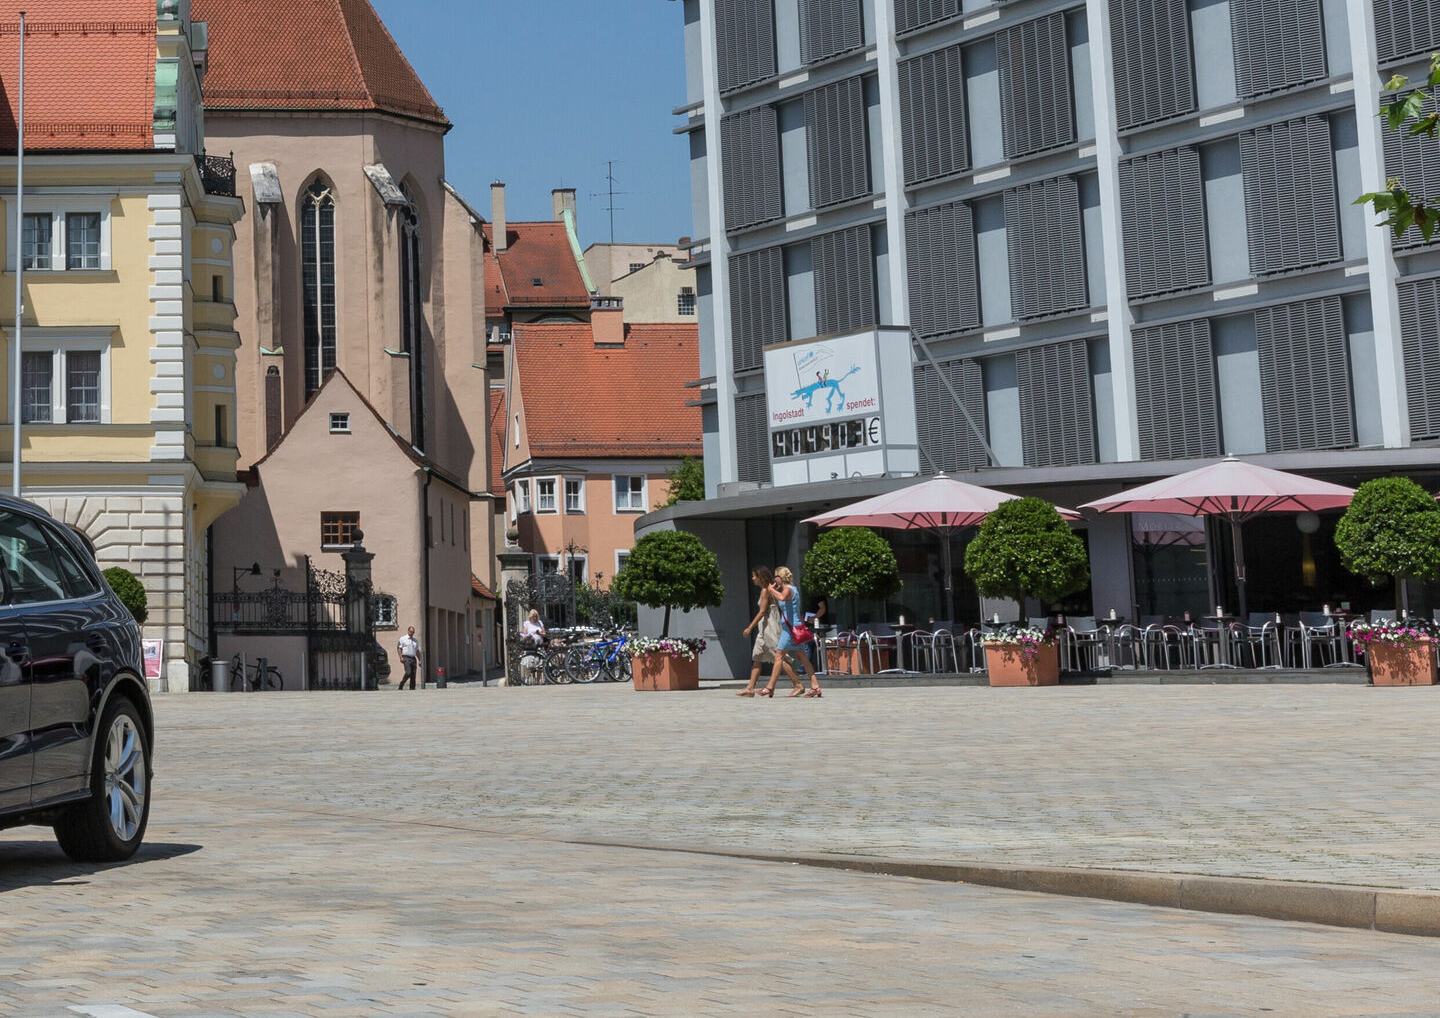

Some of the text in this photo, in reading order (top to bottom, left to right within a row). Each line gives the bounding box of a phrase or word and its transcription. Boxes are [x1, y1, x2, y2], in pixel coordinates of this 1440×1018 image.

[772, 397, 876, 422] Ingolstadt spendet:
[776, 417, 880, 456] 404903 €
